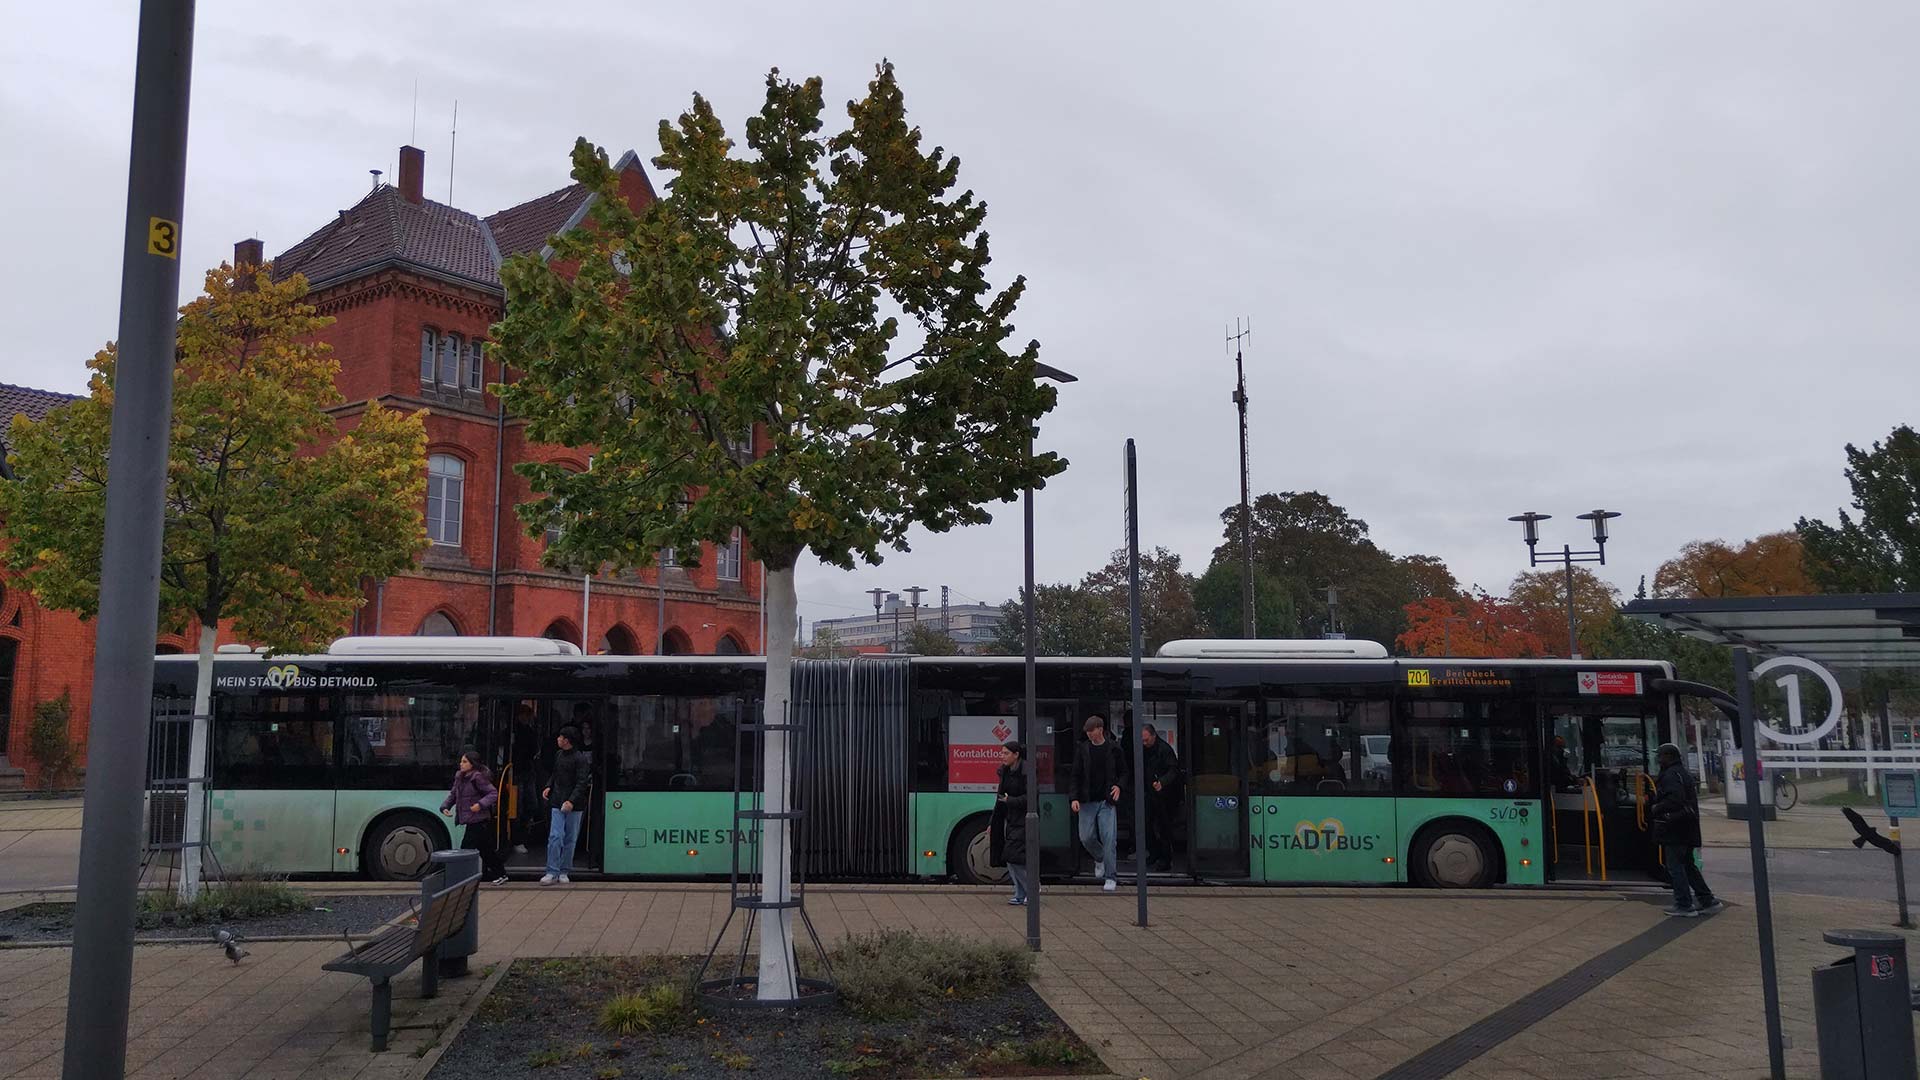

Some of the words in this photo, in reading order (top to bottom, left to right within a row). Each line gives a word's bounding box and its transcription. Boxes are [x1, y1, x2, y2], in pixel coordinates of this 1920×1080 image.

[153, 221, 175, 254] 3
[217, 676, 246, 687] MEIN
[320, 676, 378, 687] DETMOLD.
[1409, 671, 1429, 684] 701
[1775, 674, 1802, 727] 1
[953, 748, 1006, 759] Kontaktlos
[653, 829, 710, 844] MEINE
